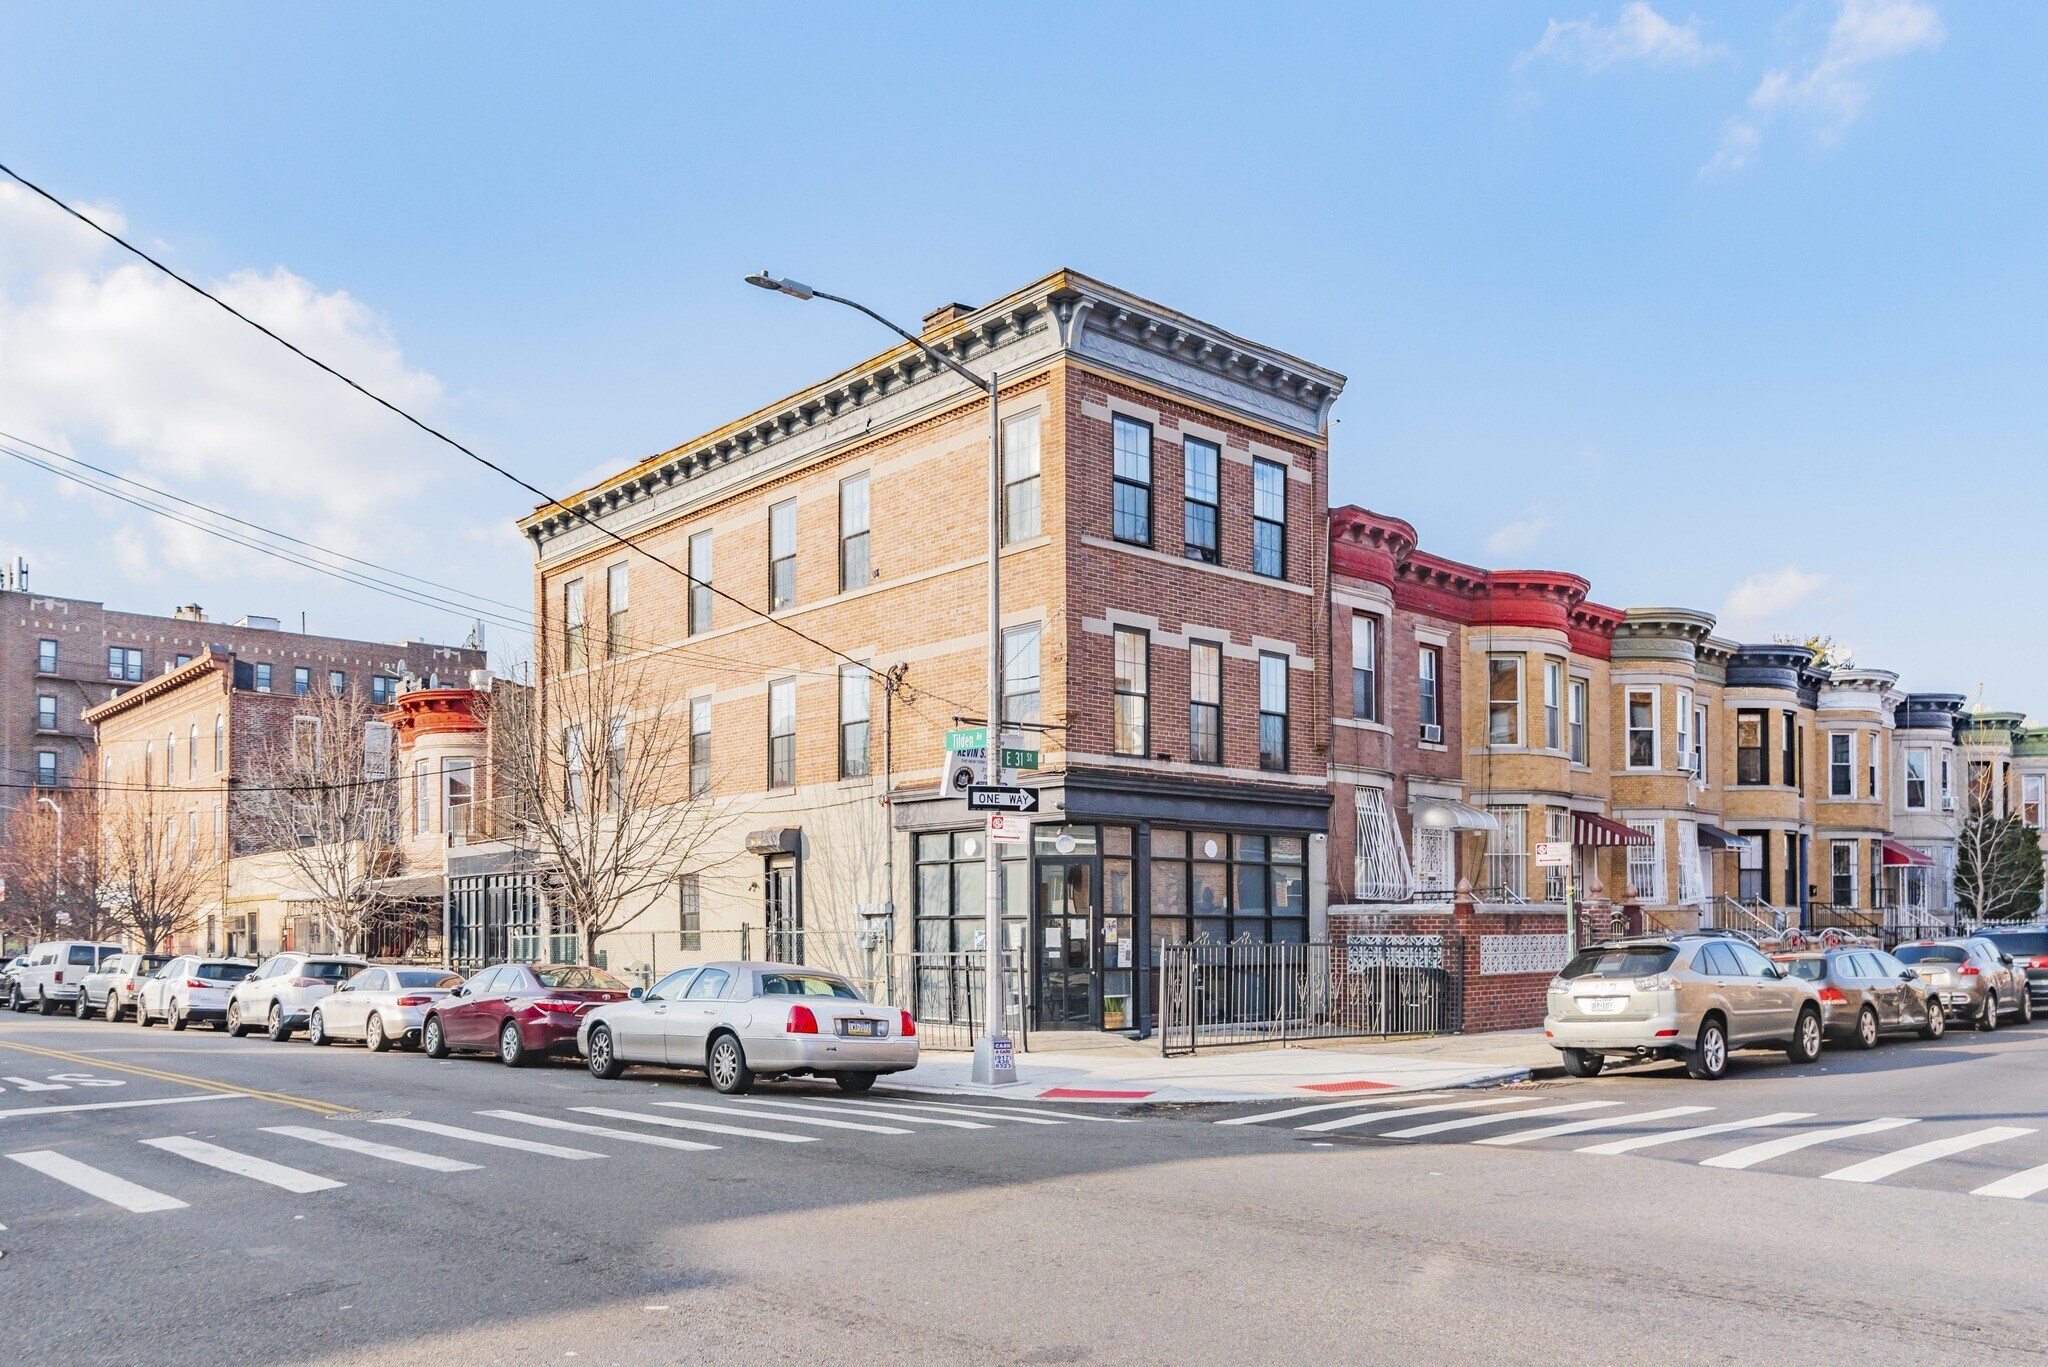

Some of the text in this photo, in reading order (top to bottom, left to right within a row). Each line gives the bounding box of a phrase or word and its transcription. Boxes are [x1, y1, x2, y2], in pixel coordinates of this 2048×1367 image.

[953, 732, 983, 748] Tilden Av
[957, 748, 979, 757] KEVIN
[1006, 751, 1033, 767] E 31 St
[979, 794, 1029, 805] ONE WAY
